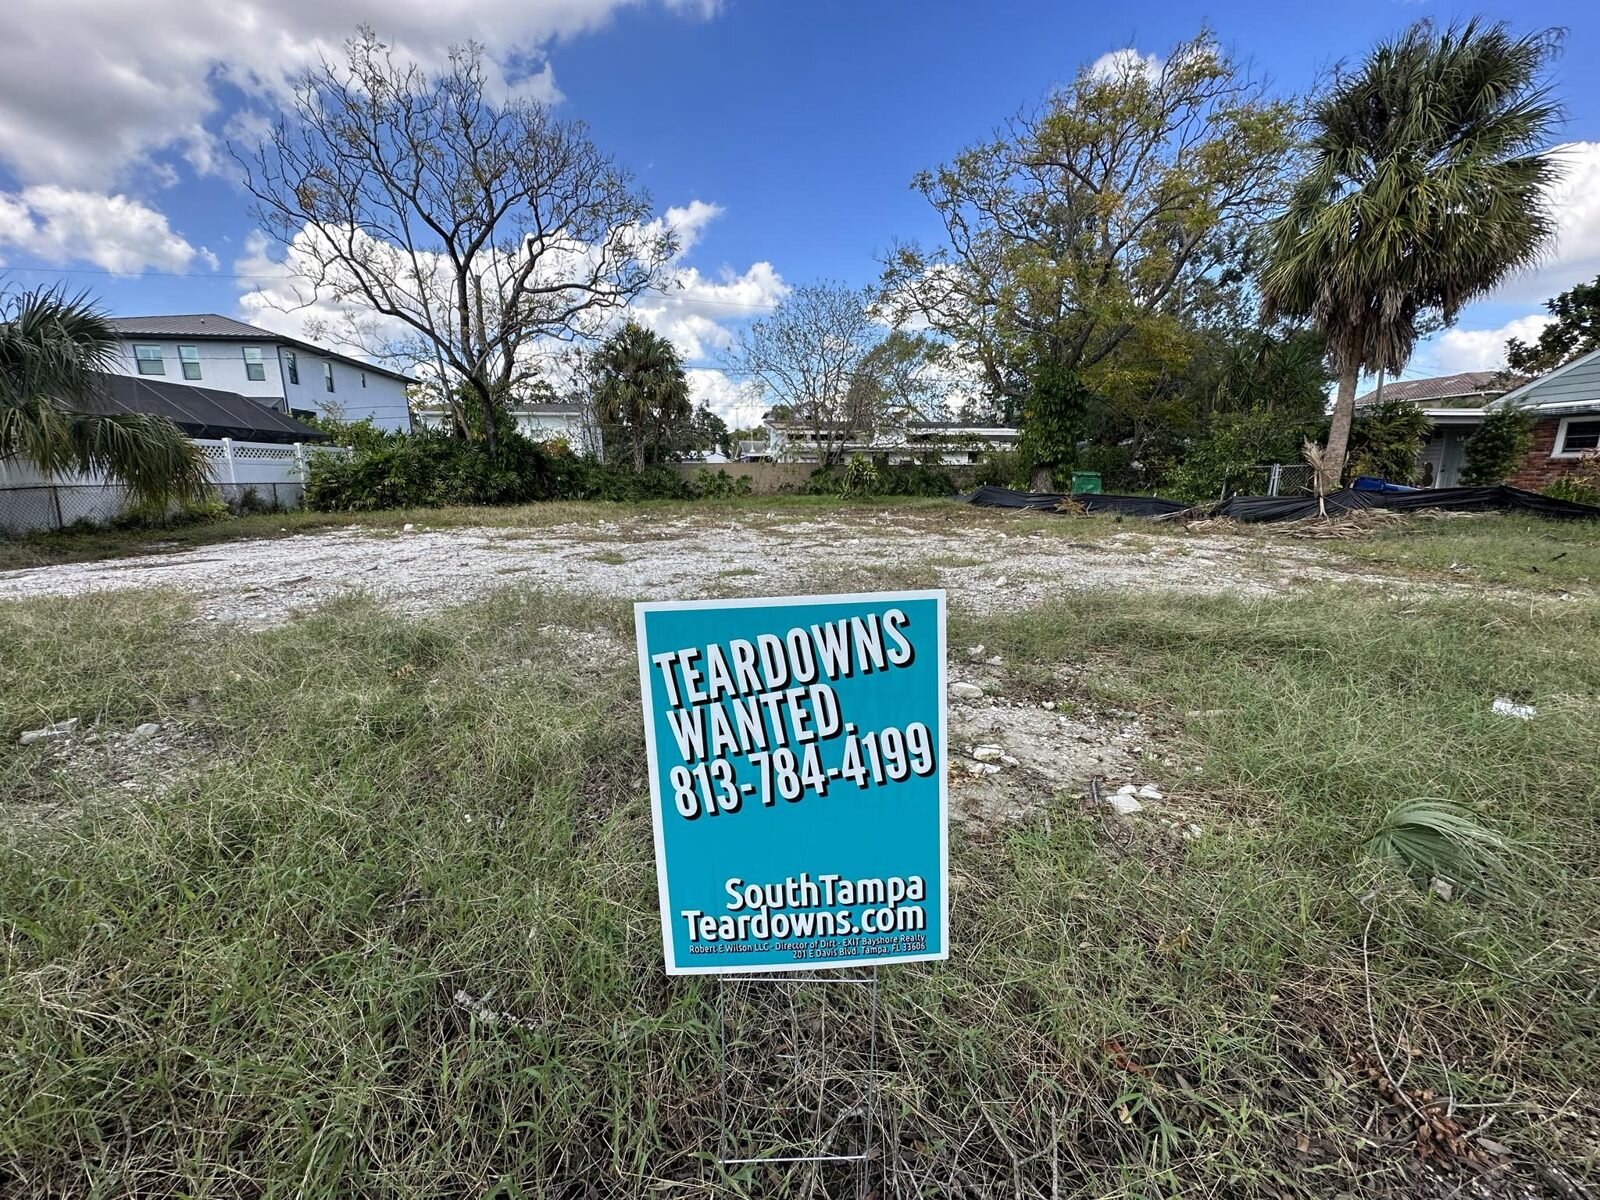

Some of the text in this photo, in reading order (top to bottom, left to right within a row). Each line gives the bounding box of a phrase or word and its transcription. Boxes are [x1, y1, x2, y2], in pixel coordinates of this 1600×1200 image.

[652, 609, 914, 707] TEARDOWNS
[666, 683, 857, 762] WANTED.
[670, 721, 934, 818] 813-784-4199
[681, 904, 924, 941] Teardowns.com
[689, 944, 717, 954] Robert
[719, 944, 724, 953] E
[726, 943, 753, 953] Wilson
[754, 942, 769, 951] LLC
[775, 942, 808, 951] Director
[810, 940, 818, 949] of
[820, 940, 836, 948] Dirt
[843, 938, 860, 946] EXIT
[862, 935, 898, 947] Bayshore
[900, 934, 925, 943] Realty
[793, 950, 806, 959] 201
[815, 949, 837, 957] Davis
[839, 947, 860, 956] Blvd.
[861, 945, 890, 955] Tampa,
[891, 944, 900, 952] FL
[903, 942, 925, 951] 33606
